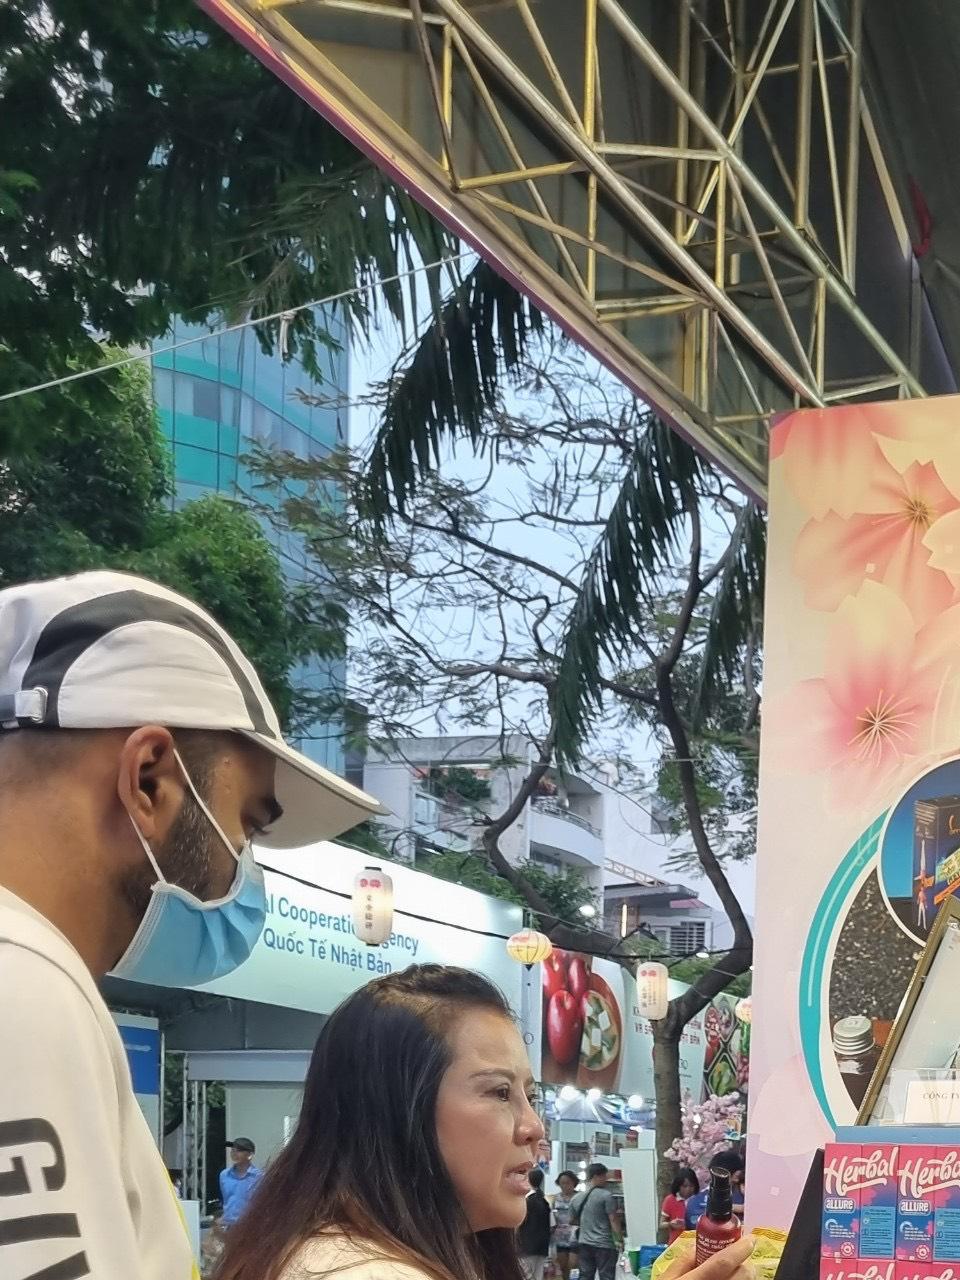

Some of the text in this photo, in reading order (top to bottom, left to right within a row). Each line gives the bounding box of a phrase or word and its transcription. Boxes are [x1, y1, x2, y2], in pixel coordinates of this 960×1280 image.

[278, 896, 356, 933] Cooperati
[263, 927, 392, 975] Quốc Tế Nhật Bản
[824, 1147, 898, 1196] Herbal
